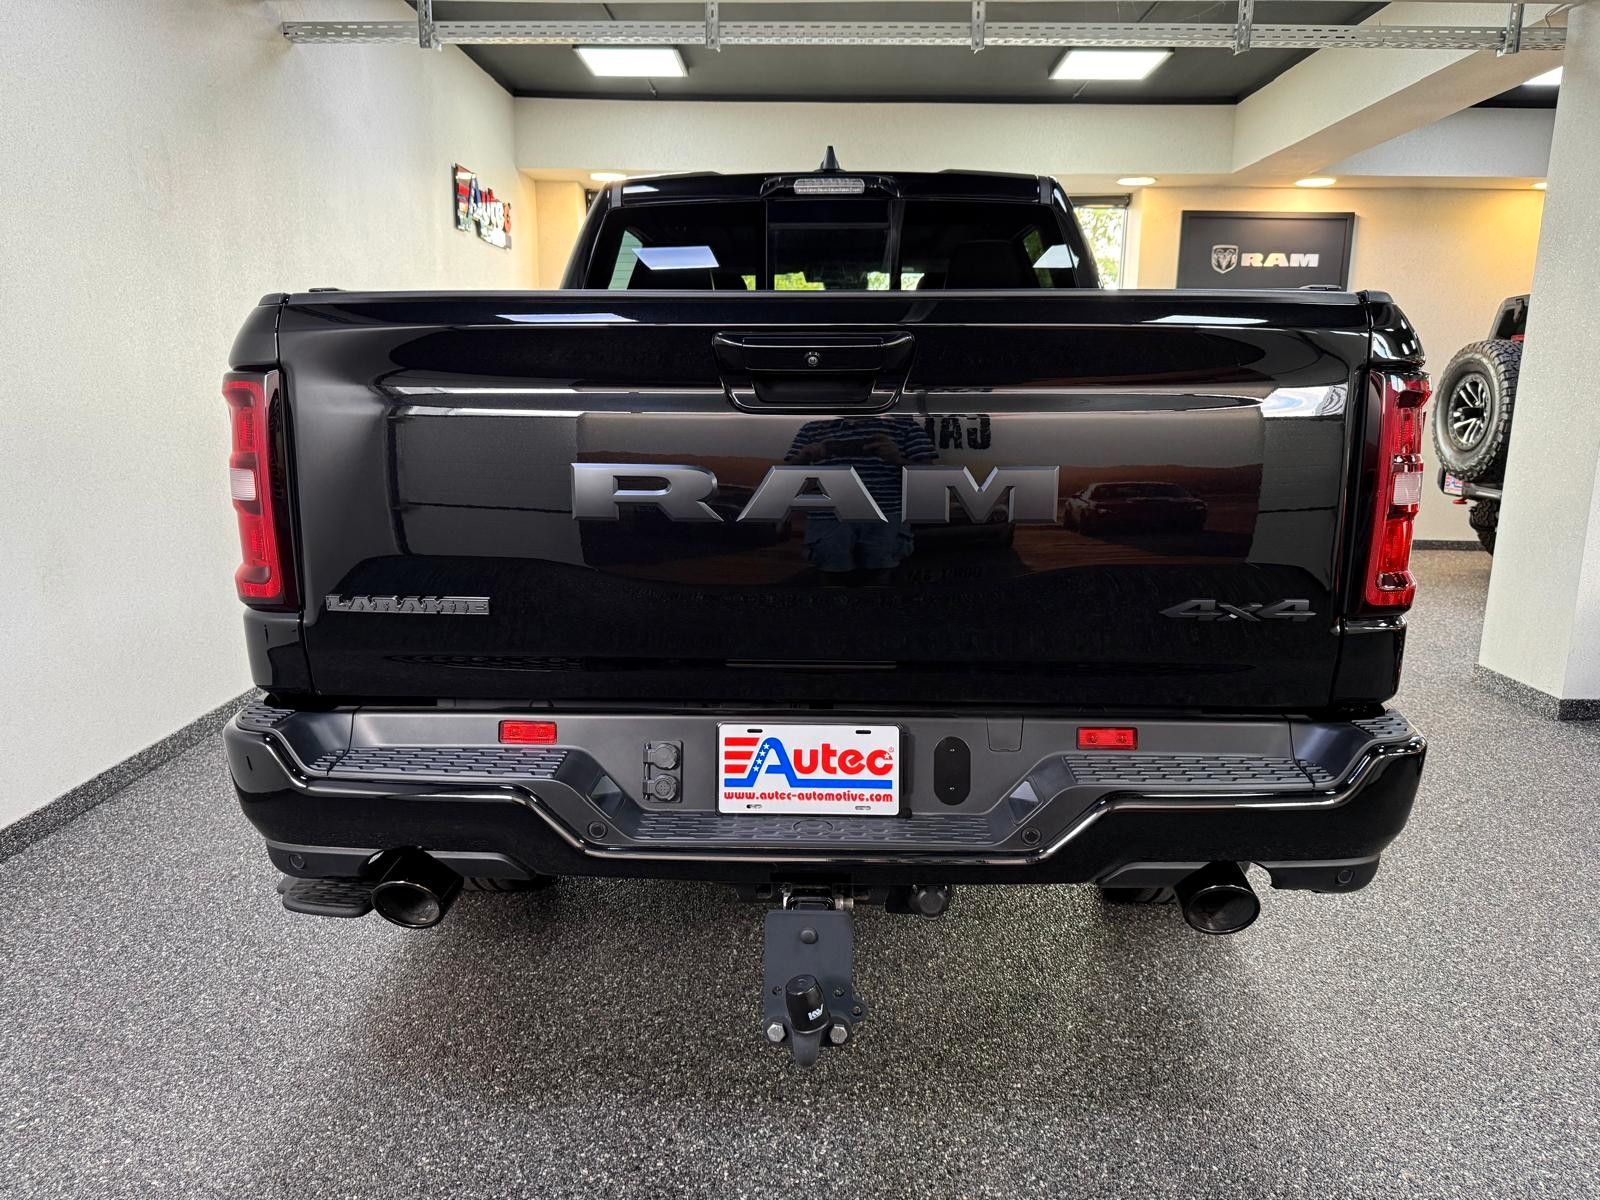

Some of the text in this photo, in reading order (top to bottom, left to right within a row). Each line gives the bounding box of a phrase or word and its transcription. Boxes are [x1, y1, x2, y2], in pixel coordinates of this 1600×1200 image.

[1240, 252, 1320, 268] RAM
[570, 462, 1061, 523] RAM
[746, 736, 894, 788] Autec
[724, 790, 893, 803] www.autec-automotive.com
